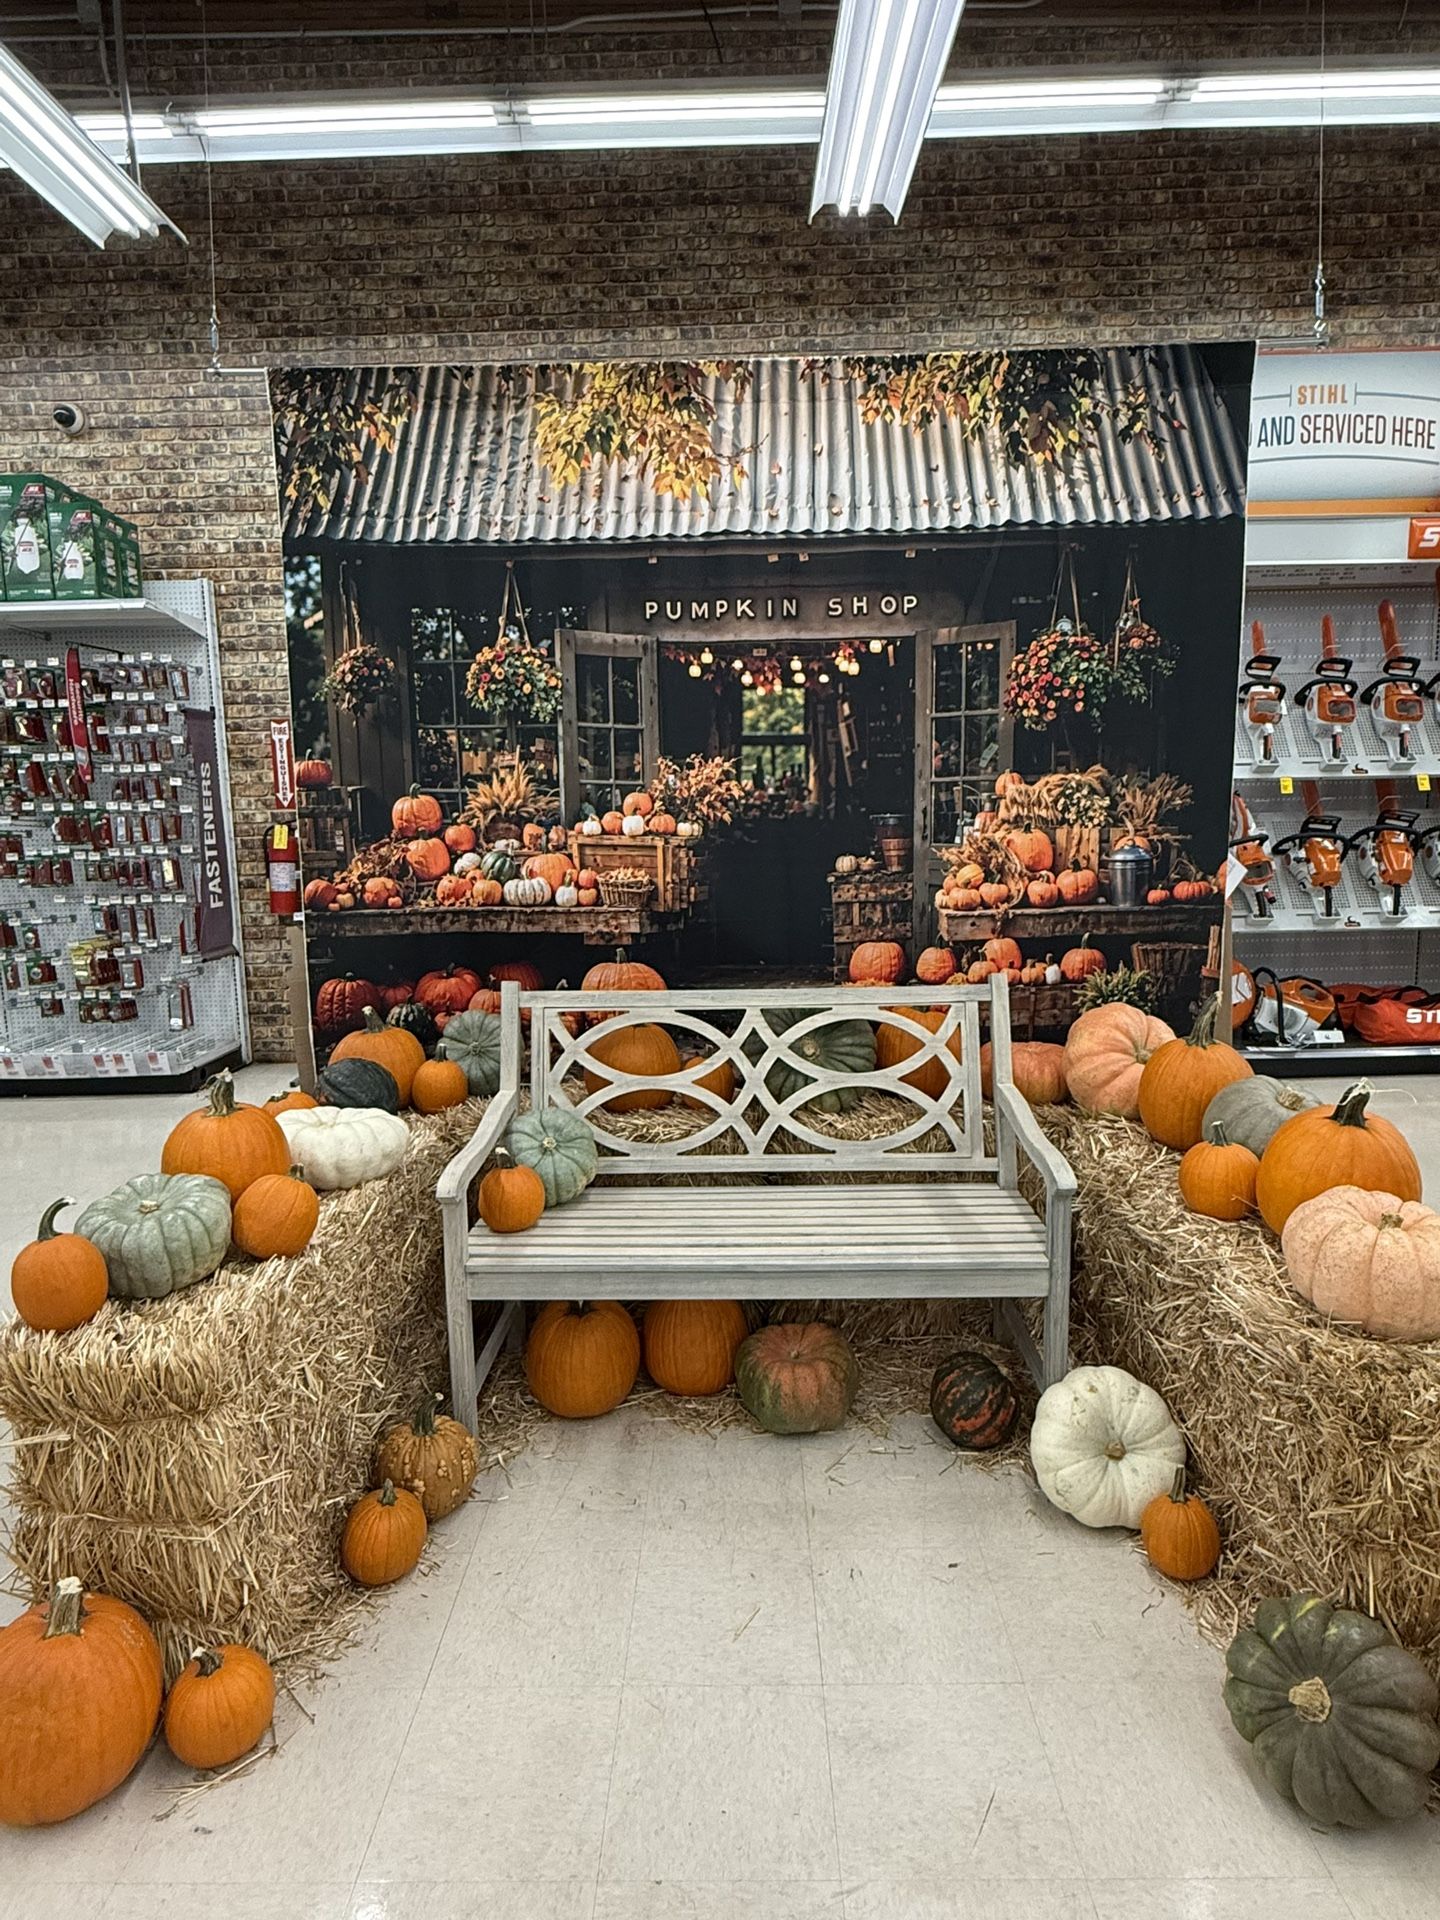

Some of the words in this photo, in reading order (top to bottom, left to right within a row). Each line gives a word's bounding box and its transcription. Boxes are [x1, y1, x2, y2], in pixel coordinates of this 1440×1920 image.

[1297, 384, 1348, 406] STIHL
[1257, 416, 1295, 448] AND
[1300, 414, 1386, 445] SERVICED
[1391, 416, 1436, 450] HERE
[645, 598, 798, 620] PUMPKIN
[827, 595, 918, 616] SHOP
[68, 678, 79, 725] Hardware
[75, 682, 84, 723] Security
[273, 726, 288, 736] FIRE
[278, 738, 288, 802] EXTINGUISHER
[201, 762, 224, 908] FASTENERS
